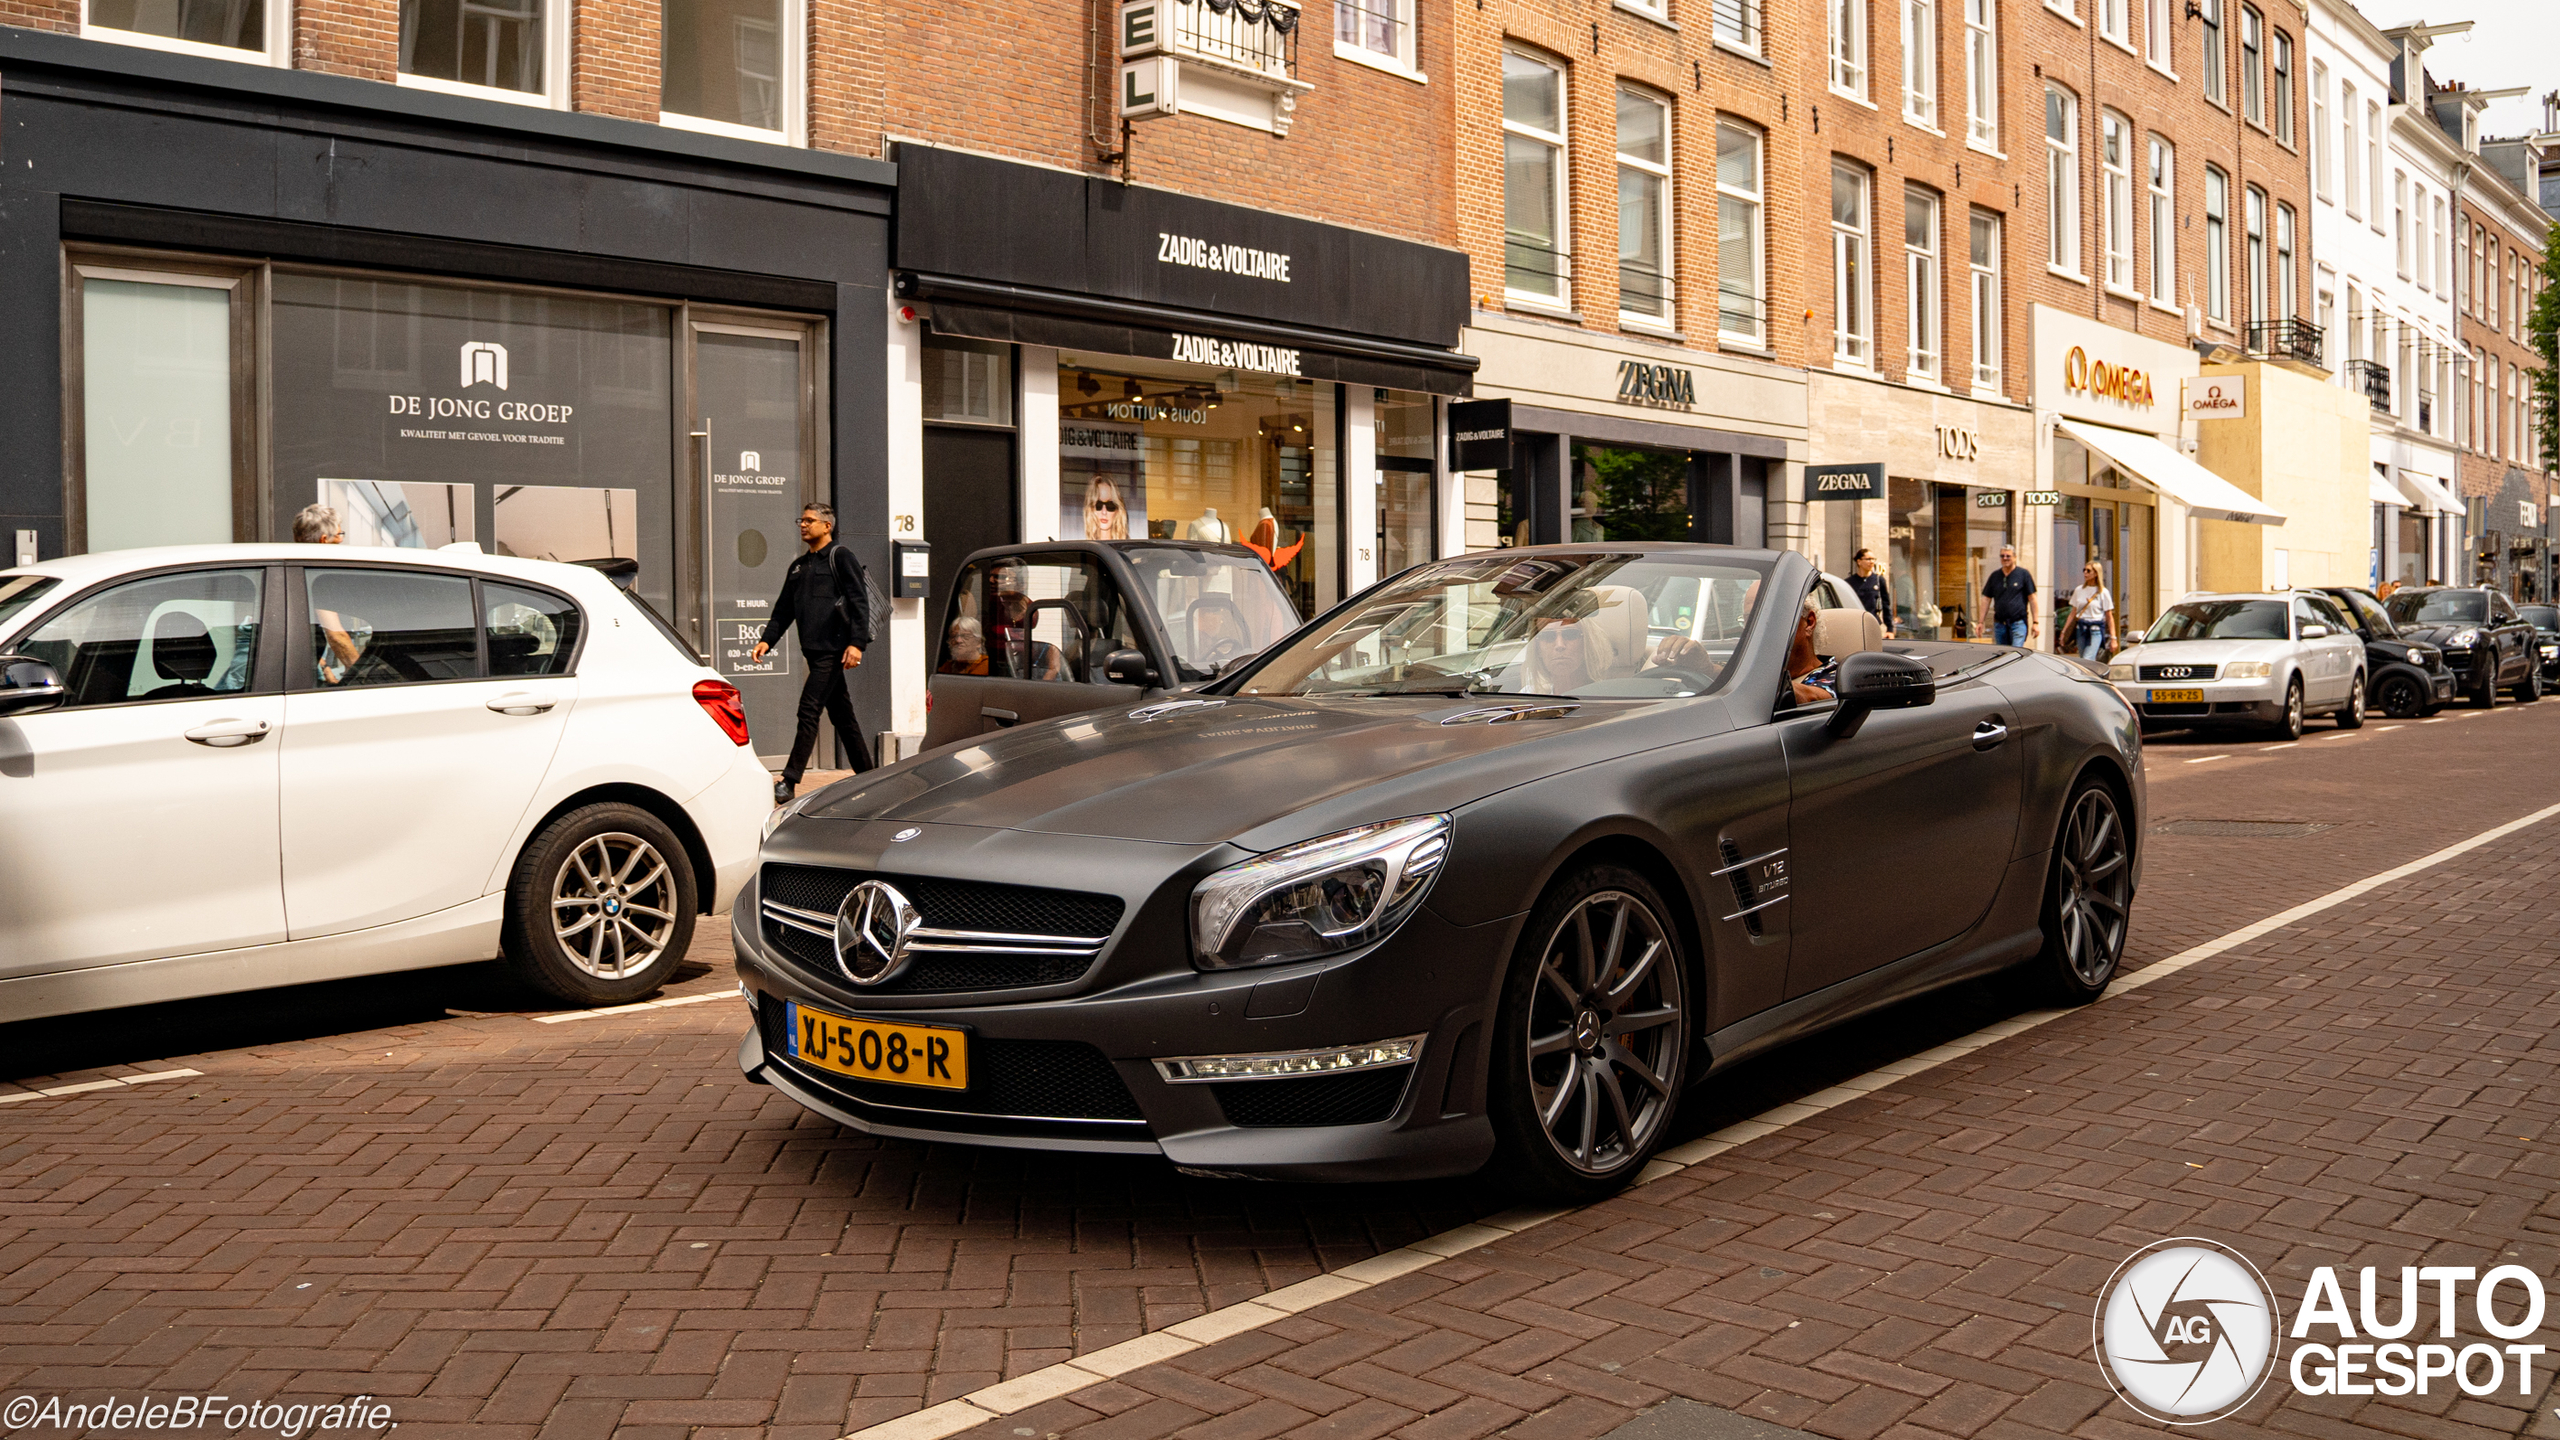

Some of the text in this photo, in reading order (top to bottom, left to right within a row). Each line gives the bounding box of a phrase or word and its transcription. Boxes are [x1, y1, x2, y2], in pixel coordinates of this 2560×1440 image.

[1158, 232, 1291, 283] ZADIG&VOLTAIRE
[1172, 333, 1302, 376] ZADIG&VOLTAIRE
[1616, 360, 1698, 405] ZEGNA
[2090, 359, 2154, 407] OMEGA
[389, 395, 573, 423] DE JONG GROEP
[2193, 398, 2238, 410] OMEGA
[400, 429, 565, 445] KWALITEIT MET GEVOEL VOOR TRADITIE
[1456, 429, 1505, 442] ZADIG&VOLTAIRE
[714, 474, 786, 485] DE JONG GROEP
[1818, 473, 1871, 491] ZEGNA
[894, 514, 915, 532] 78
[1358, 548, 1370, 561] 78
[746, 600, 769, 608] HUUR:
[2155, 691, 2199, 700] 55-RR-ZS
[1763, 860, 1785, 878] V12
[1758, 876, 1789, 893] BITURBO
[789, 1033, 798, 1047] NL
[803, 1014, 952, 1080] XJ-508-R
